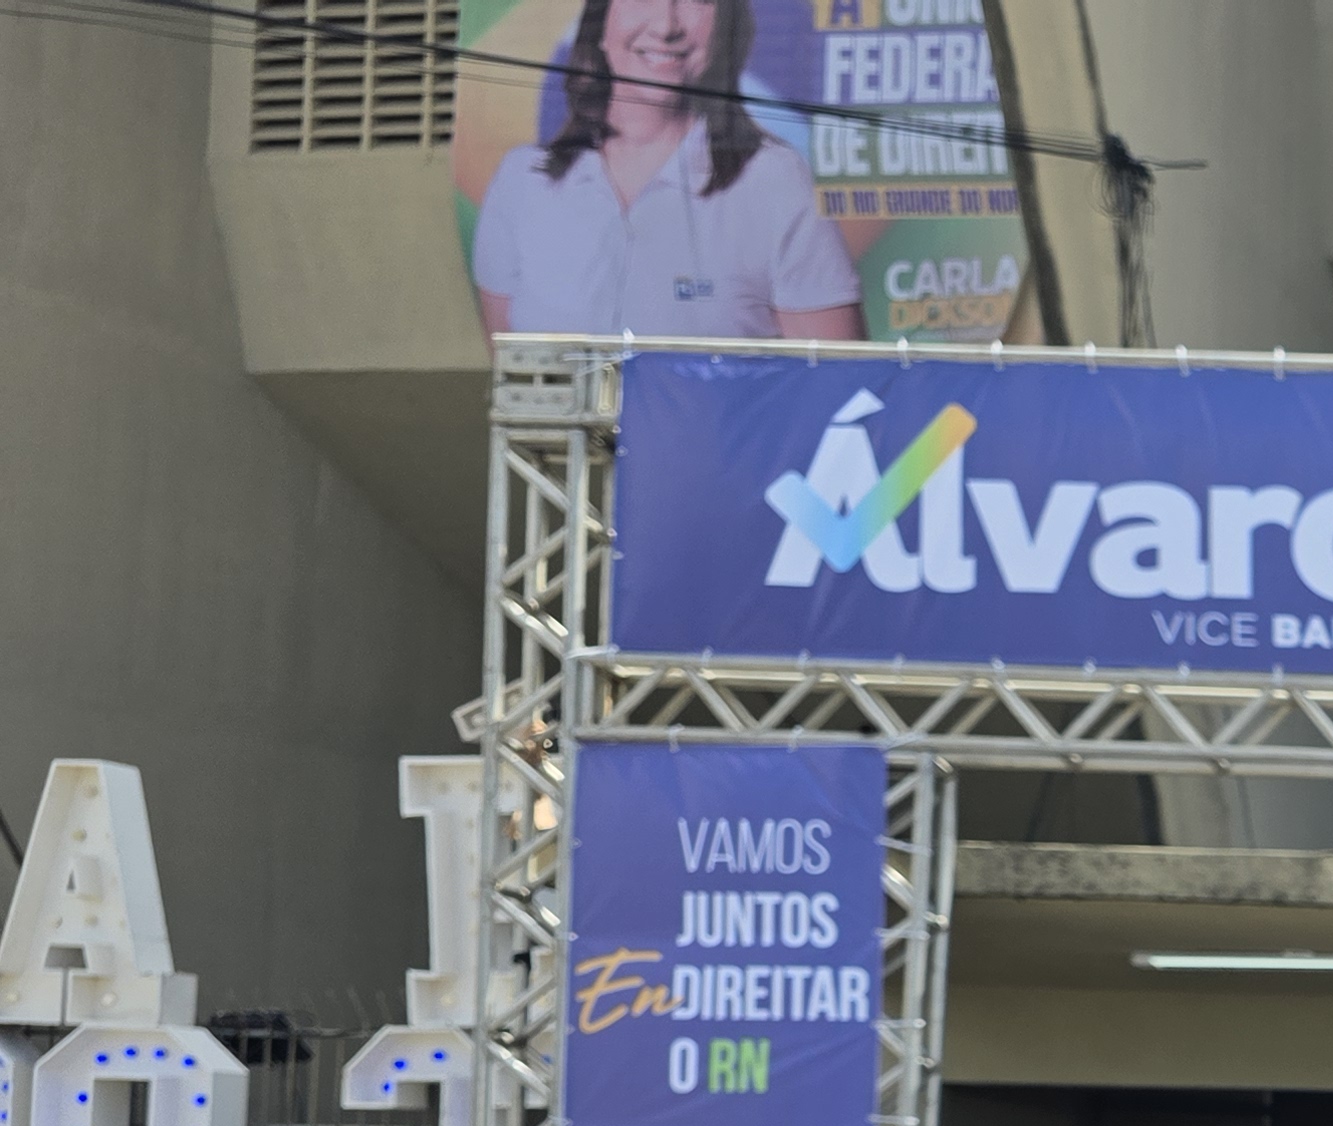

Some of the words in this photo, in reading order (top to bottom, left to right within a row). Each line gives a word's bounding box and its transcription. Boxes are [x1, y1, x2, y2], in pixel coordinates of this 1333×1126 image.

[885, 255, 1021, 300] CARLA
[1151, 611, 1259, 648] VICE
[677, 817, 833, 875] VAMOS
[675, 891, 841, 948] JUNTOS
[668, 1036, 699, 1094] O
[708, 1037, 771, 1094] RN
